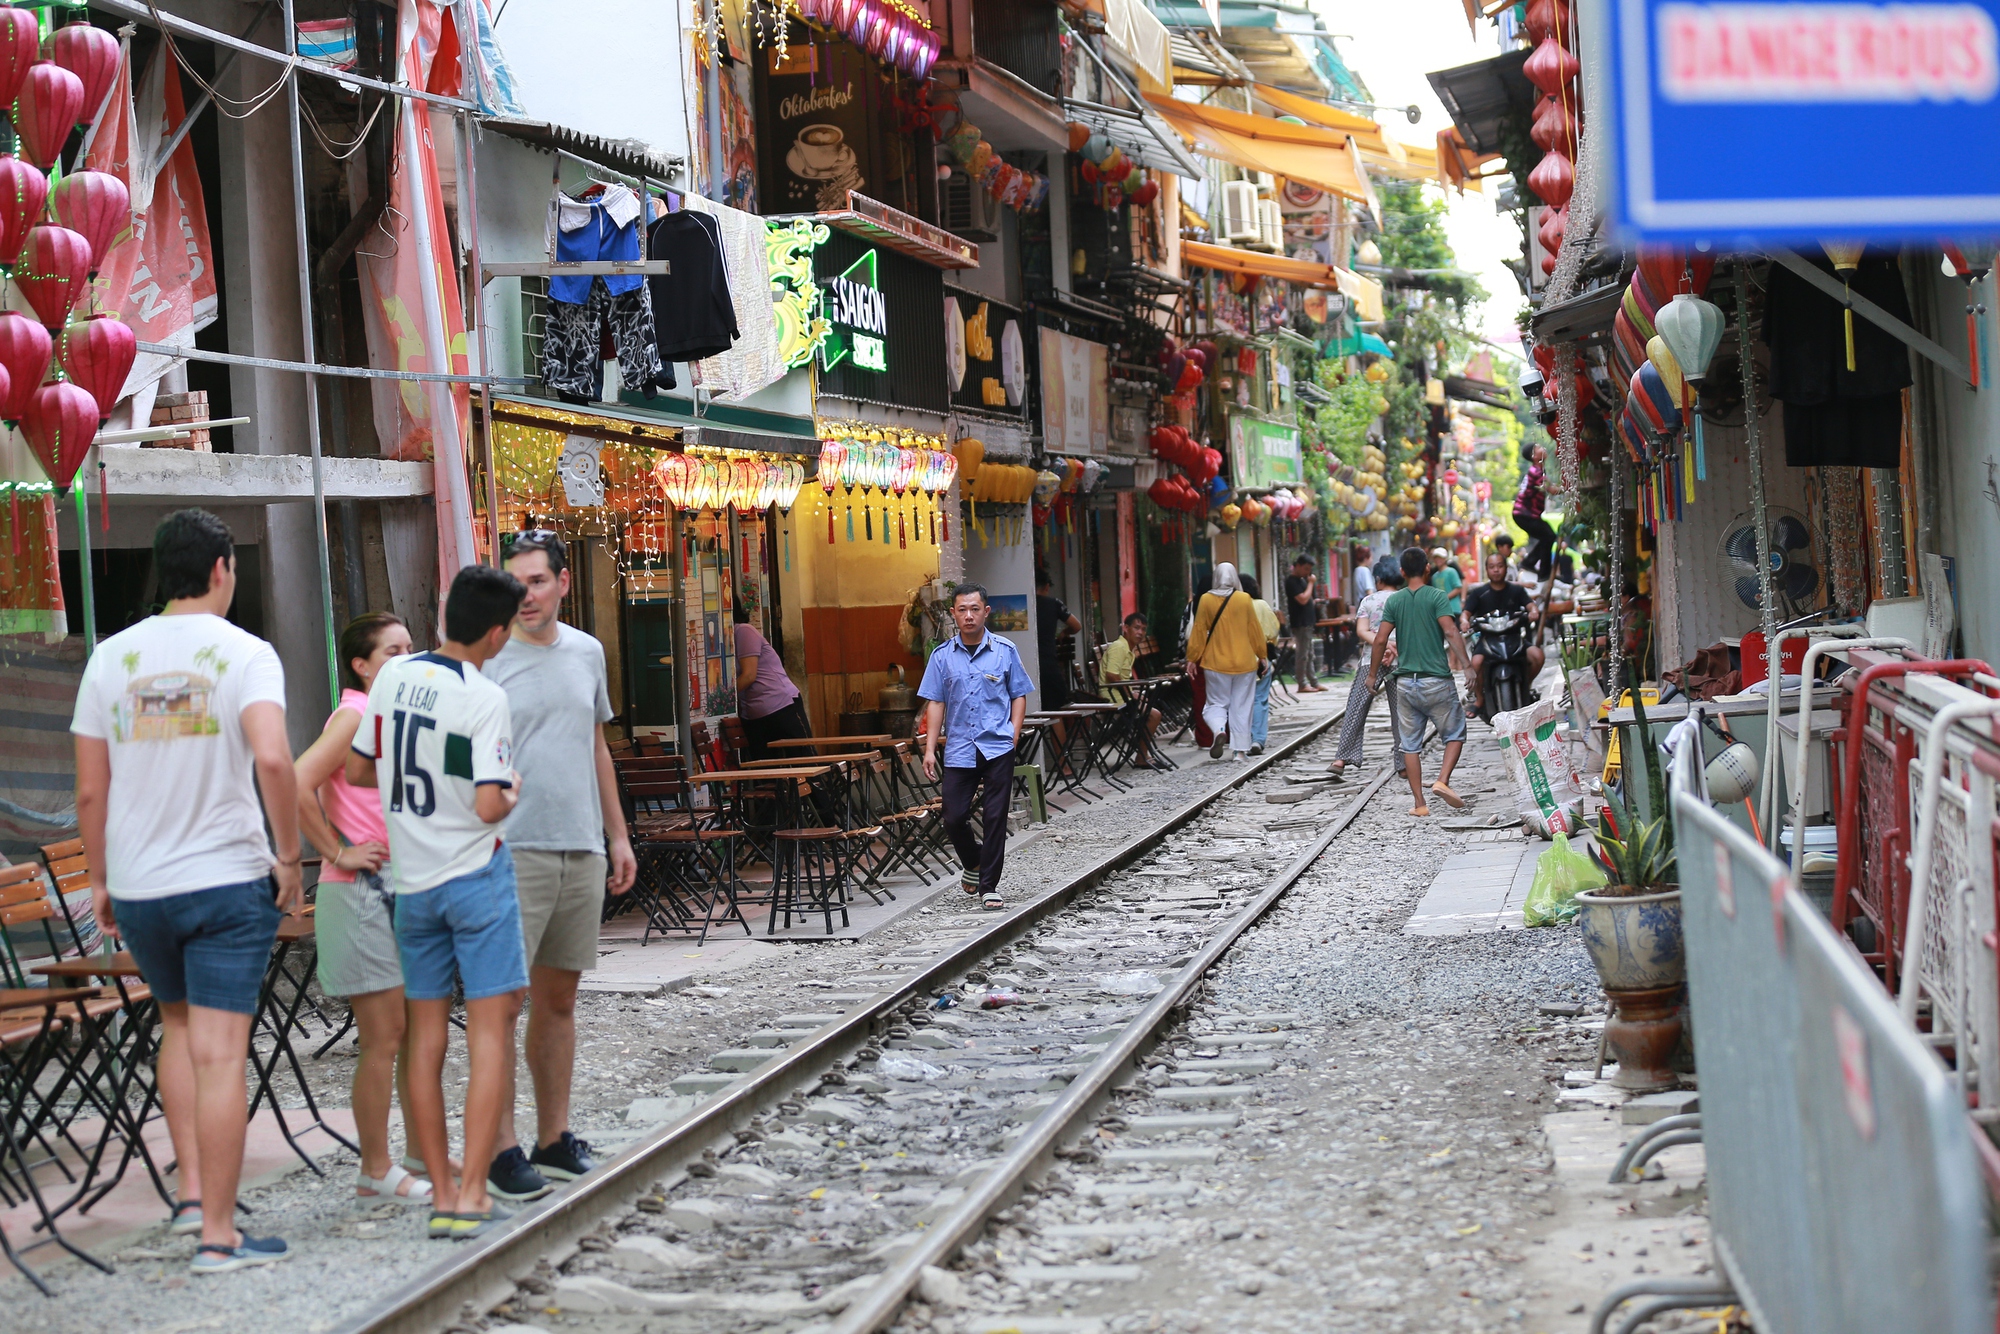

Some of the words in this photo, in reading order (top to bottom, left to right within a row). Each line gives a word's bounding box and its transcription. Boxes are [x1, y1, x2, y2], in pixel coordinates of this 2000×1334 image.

[1668, 20, 1987, 83] DANGEROUS
[780, 81, 853, 119] Oktoberfest
[840, 276, 886, 335] SAIGON
[394, 682, 405, 705] R.
[390, 709, 437, 817] 15
